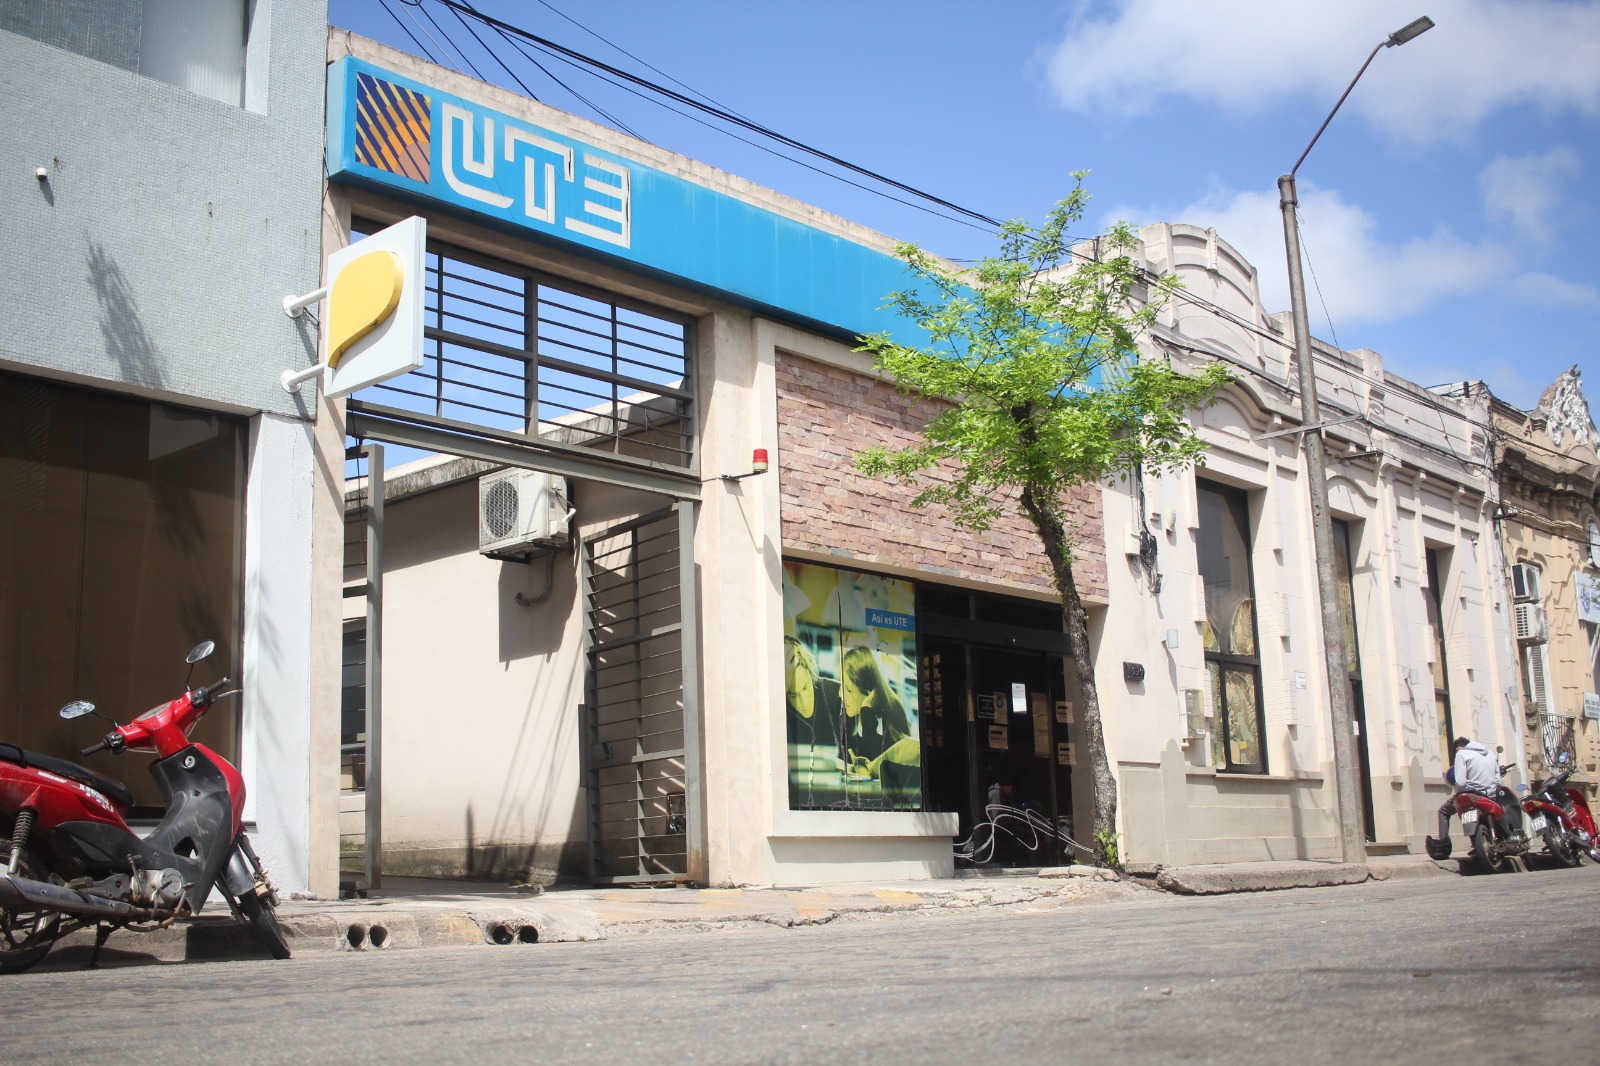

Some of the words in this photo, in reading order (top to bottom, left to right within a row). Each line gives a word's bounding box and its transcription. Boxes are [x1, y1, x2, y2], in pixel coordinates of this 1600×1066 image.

[442, 102, 631, 249] UTE
[884, 617, 893, 625] es
[894, 616, 908, 627] UTE
